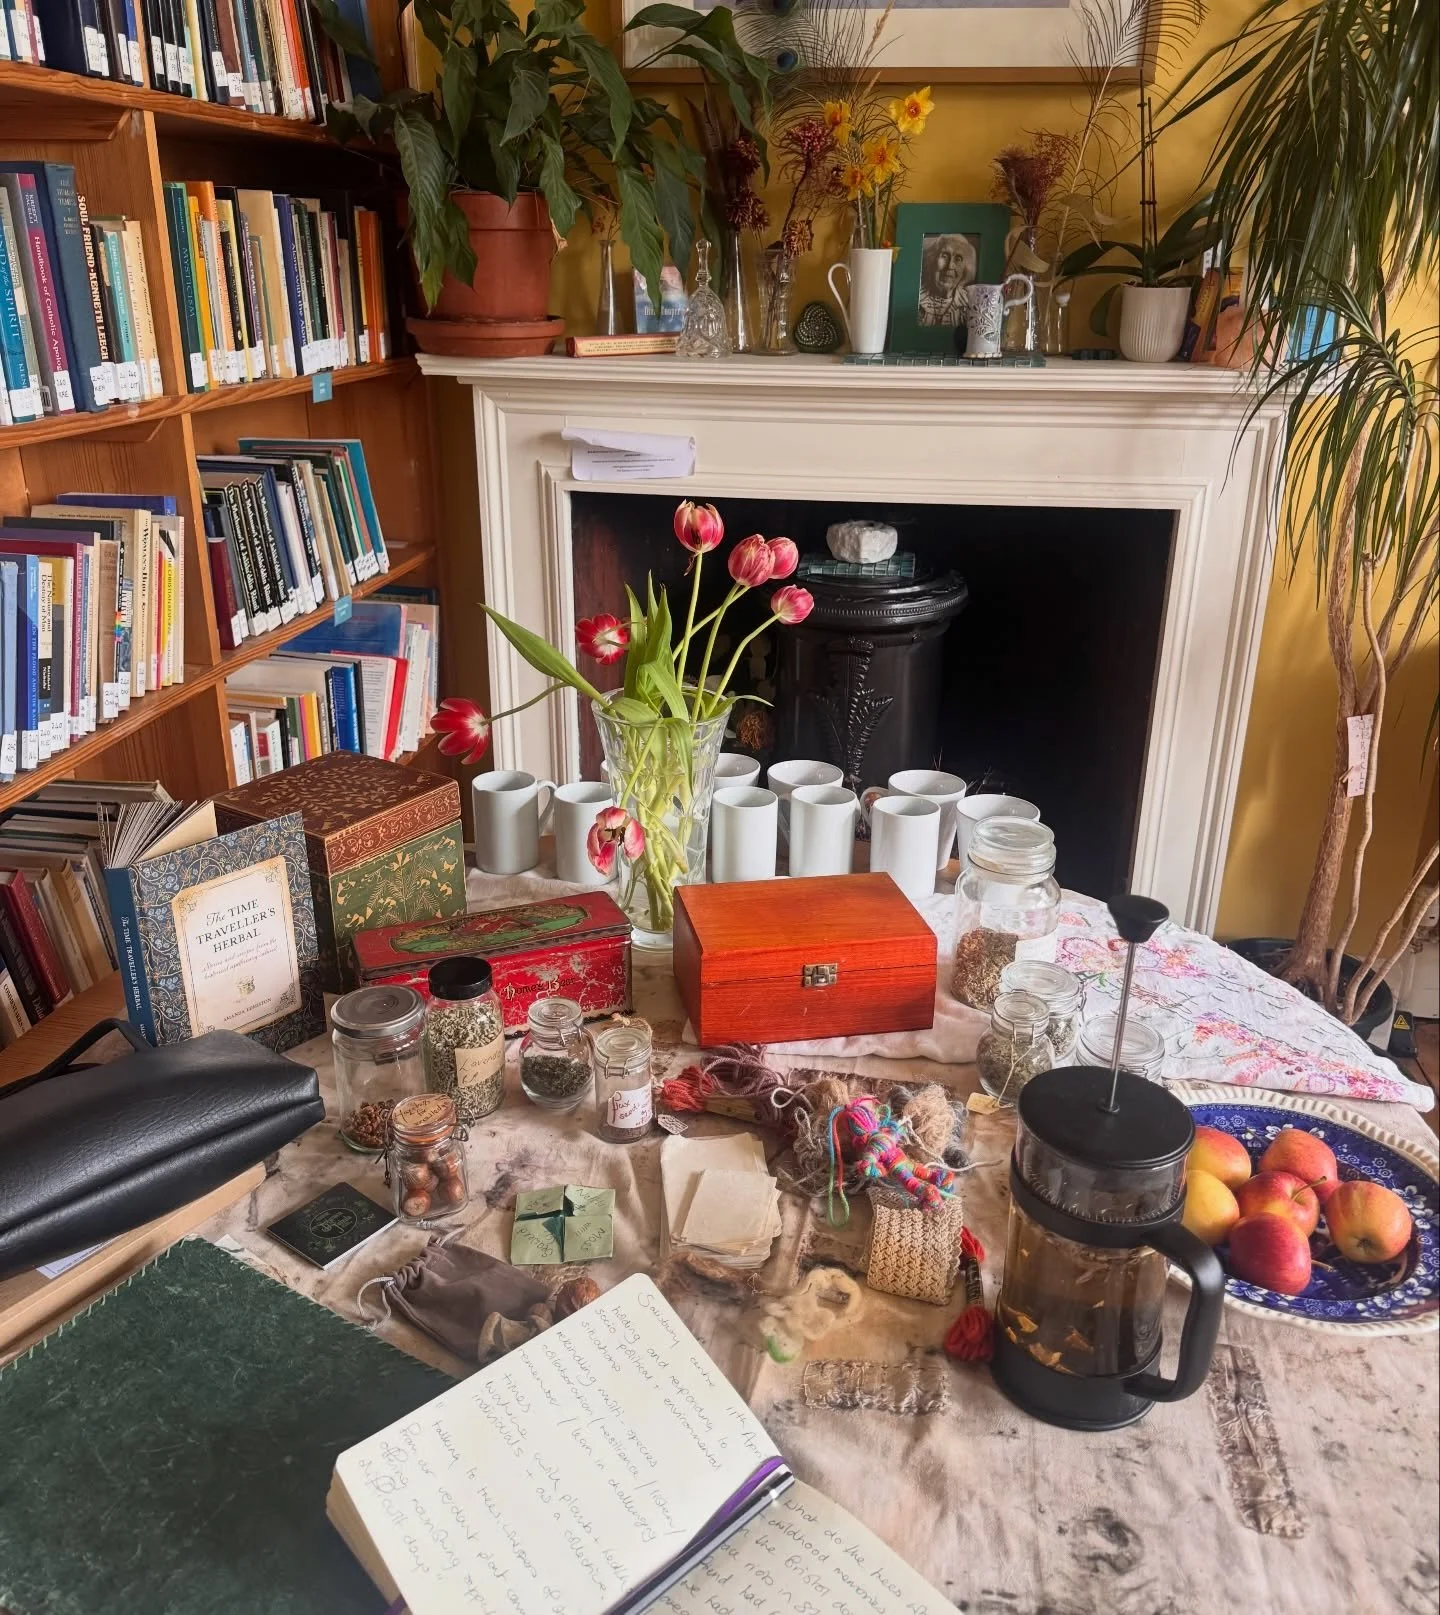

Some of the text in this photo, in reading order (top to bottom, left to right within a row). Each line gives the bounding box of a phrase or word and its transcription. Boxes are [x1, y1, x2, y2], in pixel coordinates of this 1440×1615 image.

[34, 236, 47, 284] Handbook
[290, 242, 299, 272] Alone
[43, 285, 50, 297] of
[77, 194, 109, 360] SOUL FRIEND KENNETH LEECH
[182, 246, 195, 318] MYSTICISM
[293, 274, 301, 297] with
[5, 288, 20, 338] SPIRIT
[44, 297, 56, 336] Catholic
[196, 907, 276, 945] TRAVELLER'S
[206, 899, 259, 927] The TIME
[123, 928, 131, 944] TIME
[213, 927, 262, 953] HERBAL
[126, 945, 138, 985] TRAVELLER'S
[133, 986, 143, 1011] HERBAL
[611, 1305, 641, 1345] holding
[647, 1347, 669, 1369] and
[718, 1435, 729, 1449] to
[768, 1519, 830, 1563] childhood
[784, 1500, 820, 1525] What
[824, 1529, 842, 1545] do
[842, 1544, 865, 1568] the
